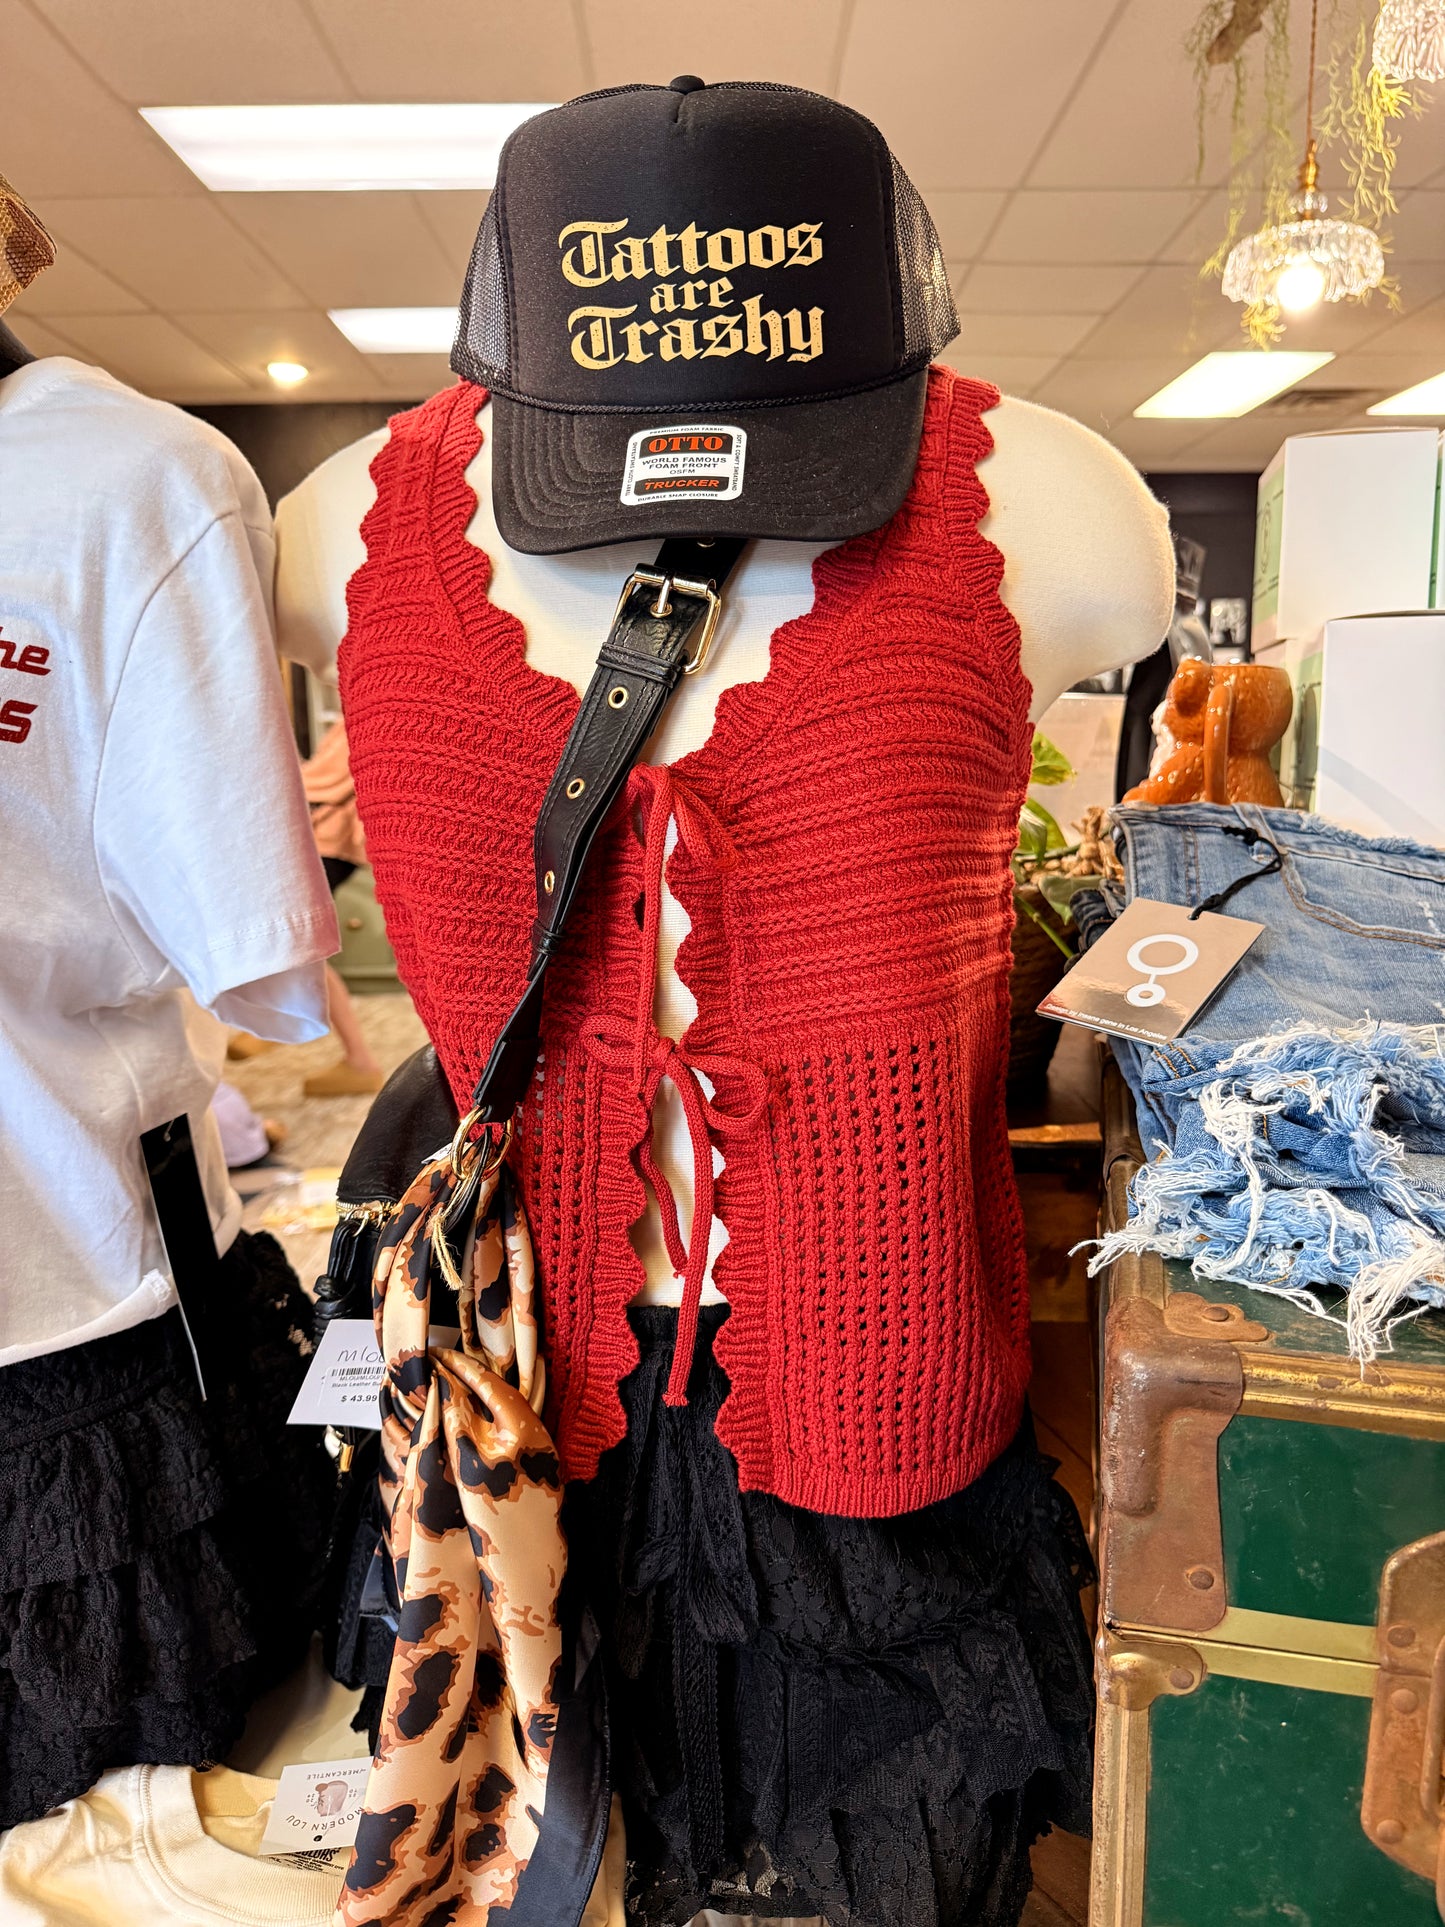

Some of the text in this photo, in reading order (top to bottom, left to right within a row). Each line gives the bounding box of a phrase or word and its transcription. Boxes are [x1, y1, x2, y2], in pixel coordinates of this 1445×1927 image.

[558, 218, 823, 288] Tattoos
[650, 277, 734, 314] are
[567, 294, 824, 370] Trashy
[648, 436, 723, 453] OTTO
[642, 457, 679, 466] WORLD
[644, 479, 720, 491] TRUCKER
[1125, 1024, 1140, 1033] Los
[1138, 1027, 1168, 1041] Angeles
[341, 1394, 378, 1402] $ 43.99
[306, 1769, 360, 1780] MERCANTILE
[286, 1806, 364, 1831] MODERN LOU
